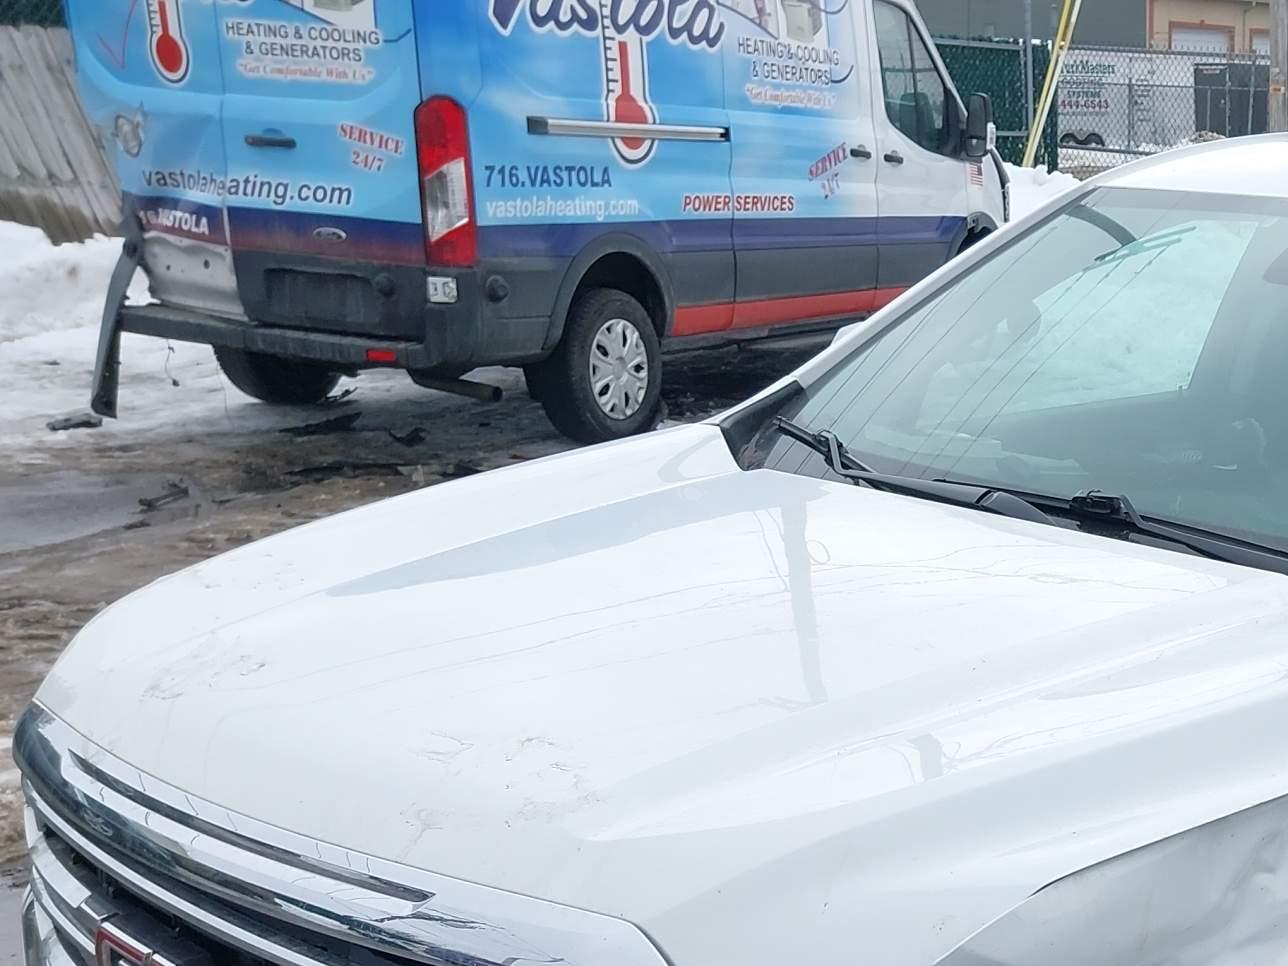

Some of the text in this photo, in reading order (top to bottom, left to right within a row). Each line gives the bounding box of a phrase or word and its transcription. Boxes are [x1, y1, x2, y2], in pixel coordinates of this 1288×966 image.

[225, 21, 381, 45] HEATING & COOLING
[244, 41, 363, 62] & GENERATORS
[737, 37, 840, 66] HEATING & COOLING
[751, 60, 831, 85] & GENERATORS
[340, 123, 405, 156] SERVICE
[352, 150, 385, 172] 24/7
[807, 142, 849, 182] SERVICE
[142, 169, 353, 207] vastolaheating.com
[484, 165, 612, 189] 716.VASTOLA
[486, 196, 640, 221] vastolaheating.com
[682, 195, 795, 212] POWER SERVICES
